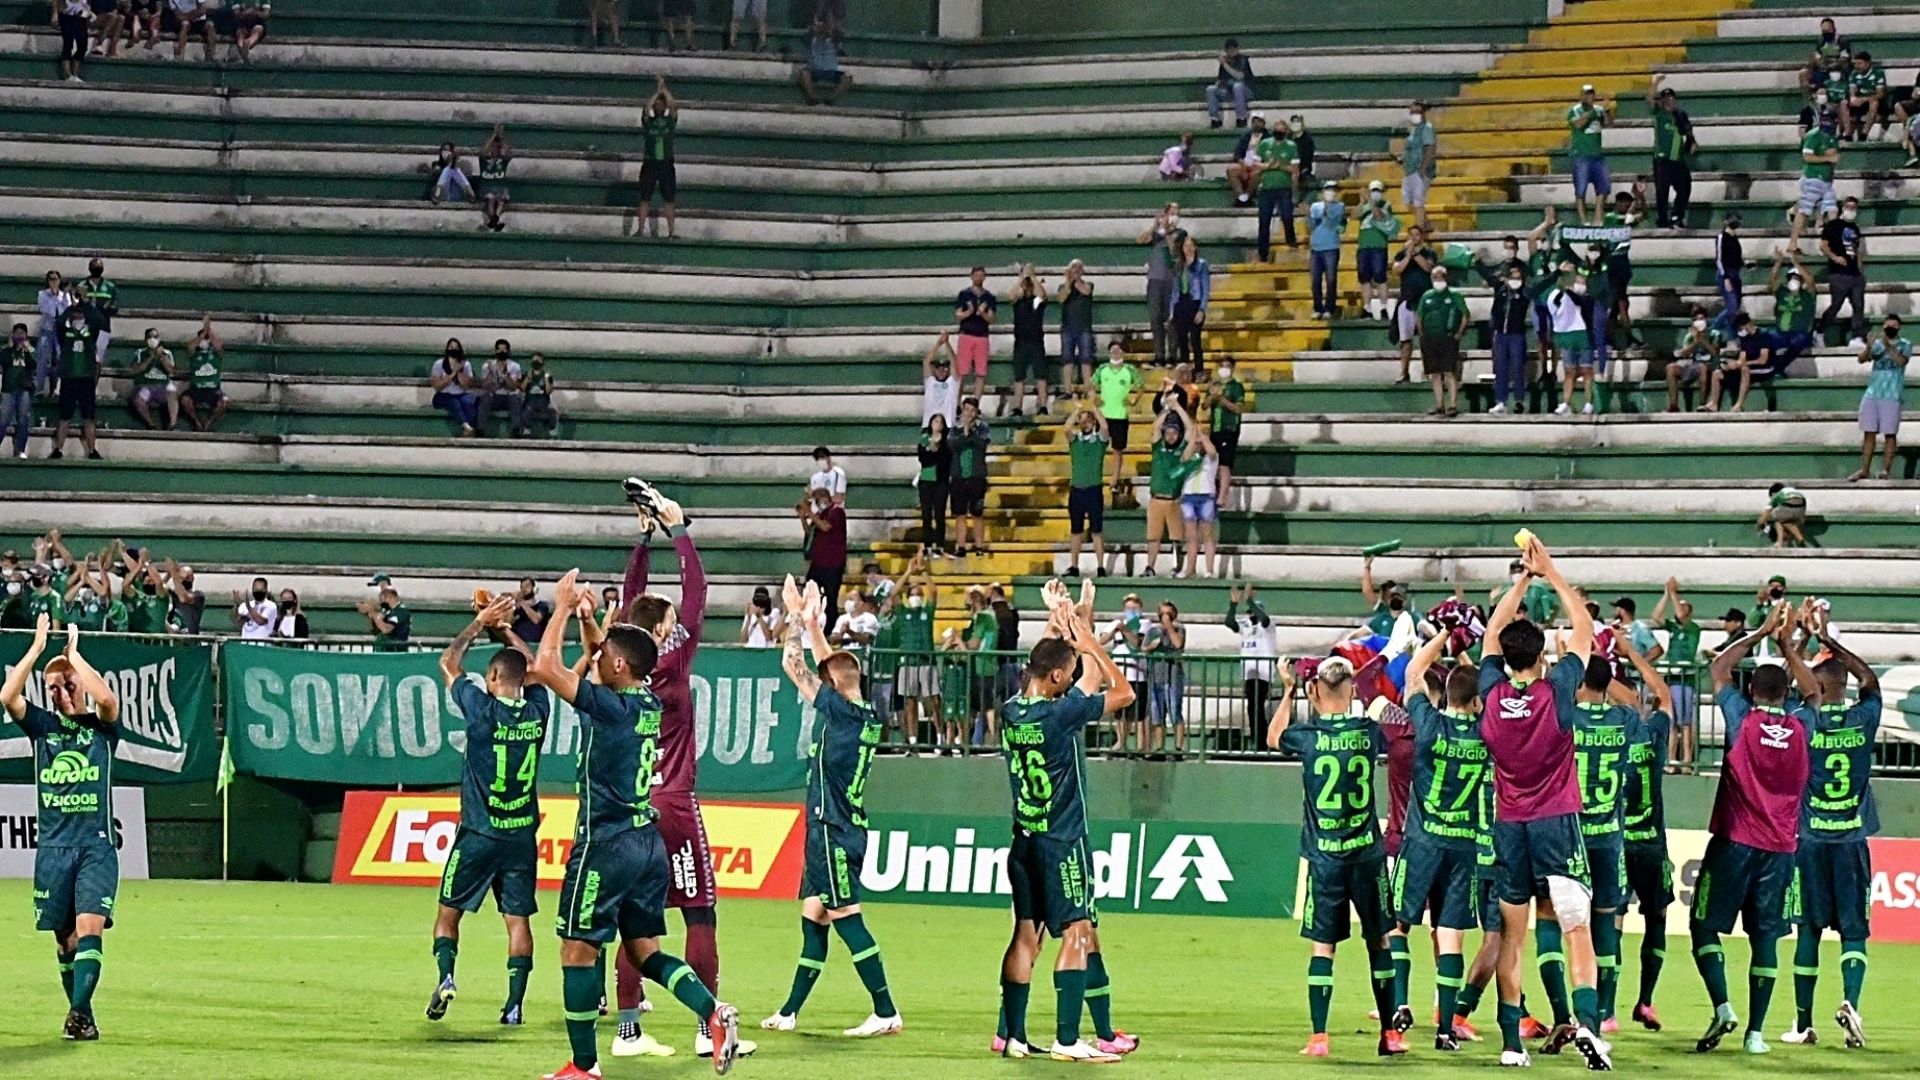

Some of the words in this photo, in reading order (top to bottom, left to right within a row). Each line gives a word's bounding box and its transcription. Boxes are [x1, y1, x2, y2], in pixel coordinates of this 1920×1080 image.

[508, 726, 543, 741] BUGIO
[1015, 732, 1045, 745] BUGIO
[1331, 738, 1371, 751] BUGIO
[1585, 735, 1626, 747] BUGIO
[1825, 734, 1866, 749] BUGIO
[490, 743, 537, 793] 14
[635, 738, 655, 797] 8
[1447, 747, 1488, 760] BUGIO
[40, 765, 99, 784] aurora
[1314, 754, 1370, 809] 23
[1427, 758, 1483, 810] 17
[1574, 751, 1619, 803] 15
[1824, 753, 1851, 798] 3
[1317, 830, 1374, 852] Unimed
[1810, 815, 1862, 830] Unimed
[672, 853, 683, 890] GRUPO
[681, 839, 698, 899] CETRIC
[1058, 861, 1071, 899] GRUPO
[1067, 848, 1084, 908] CETRIC
